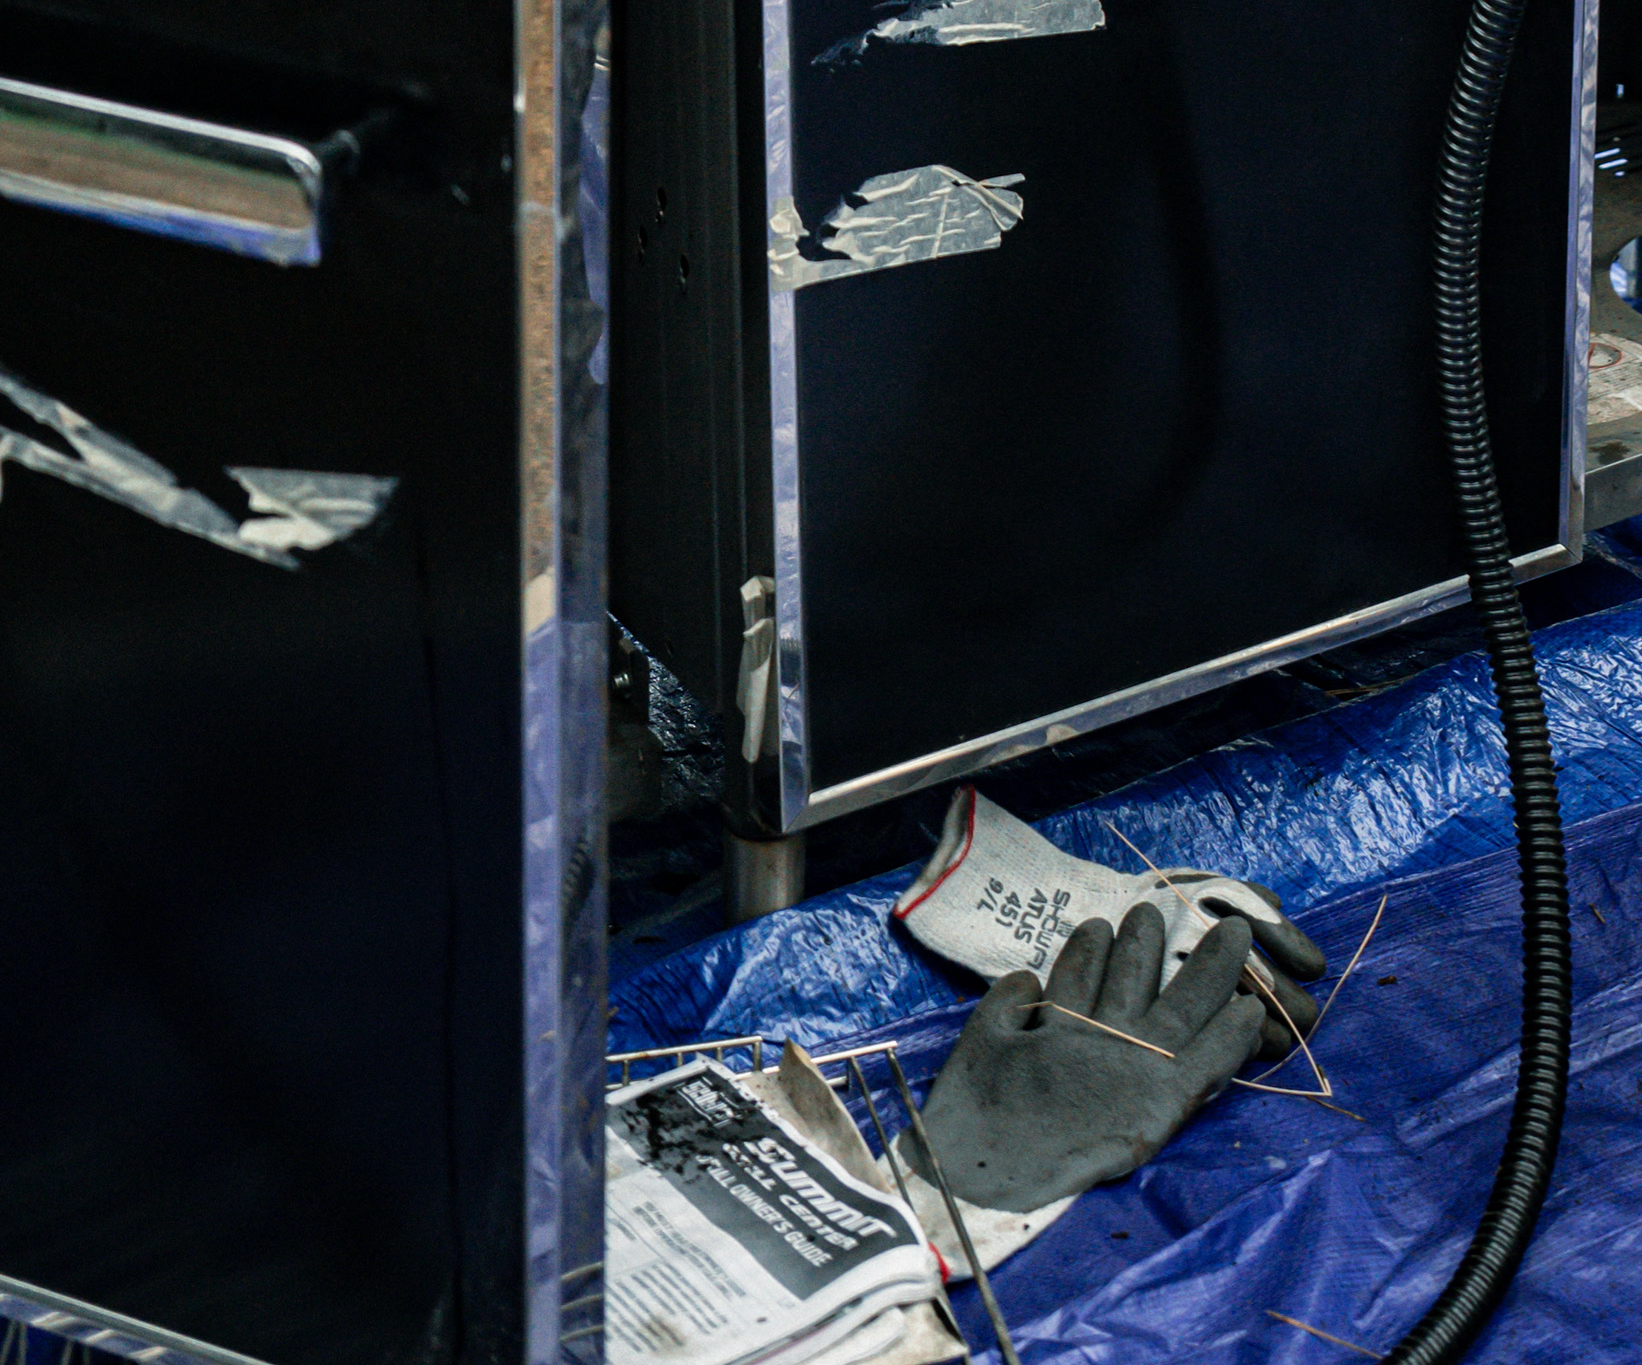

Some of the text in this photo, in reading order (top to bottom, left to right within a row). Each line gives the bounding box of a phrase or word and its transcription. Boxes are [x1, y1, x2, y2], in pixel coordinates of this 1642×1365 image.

[977, 877, 1004, 912] 9/L
[995, 891, 1022, 927] 451
[1014, 887, 1048, 944] ATLAS
[1026, 888, 1071, 970] SHOWA
[730, 1183, 793, 1234] OWNER'S
[783, 1229, 833, 1268] GUIDE
